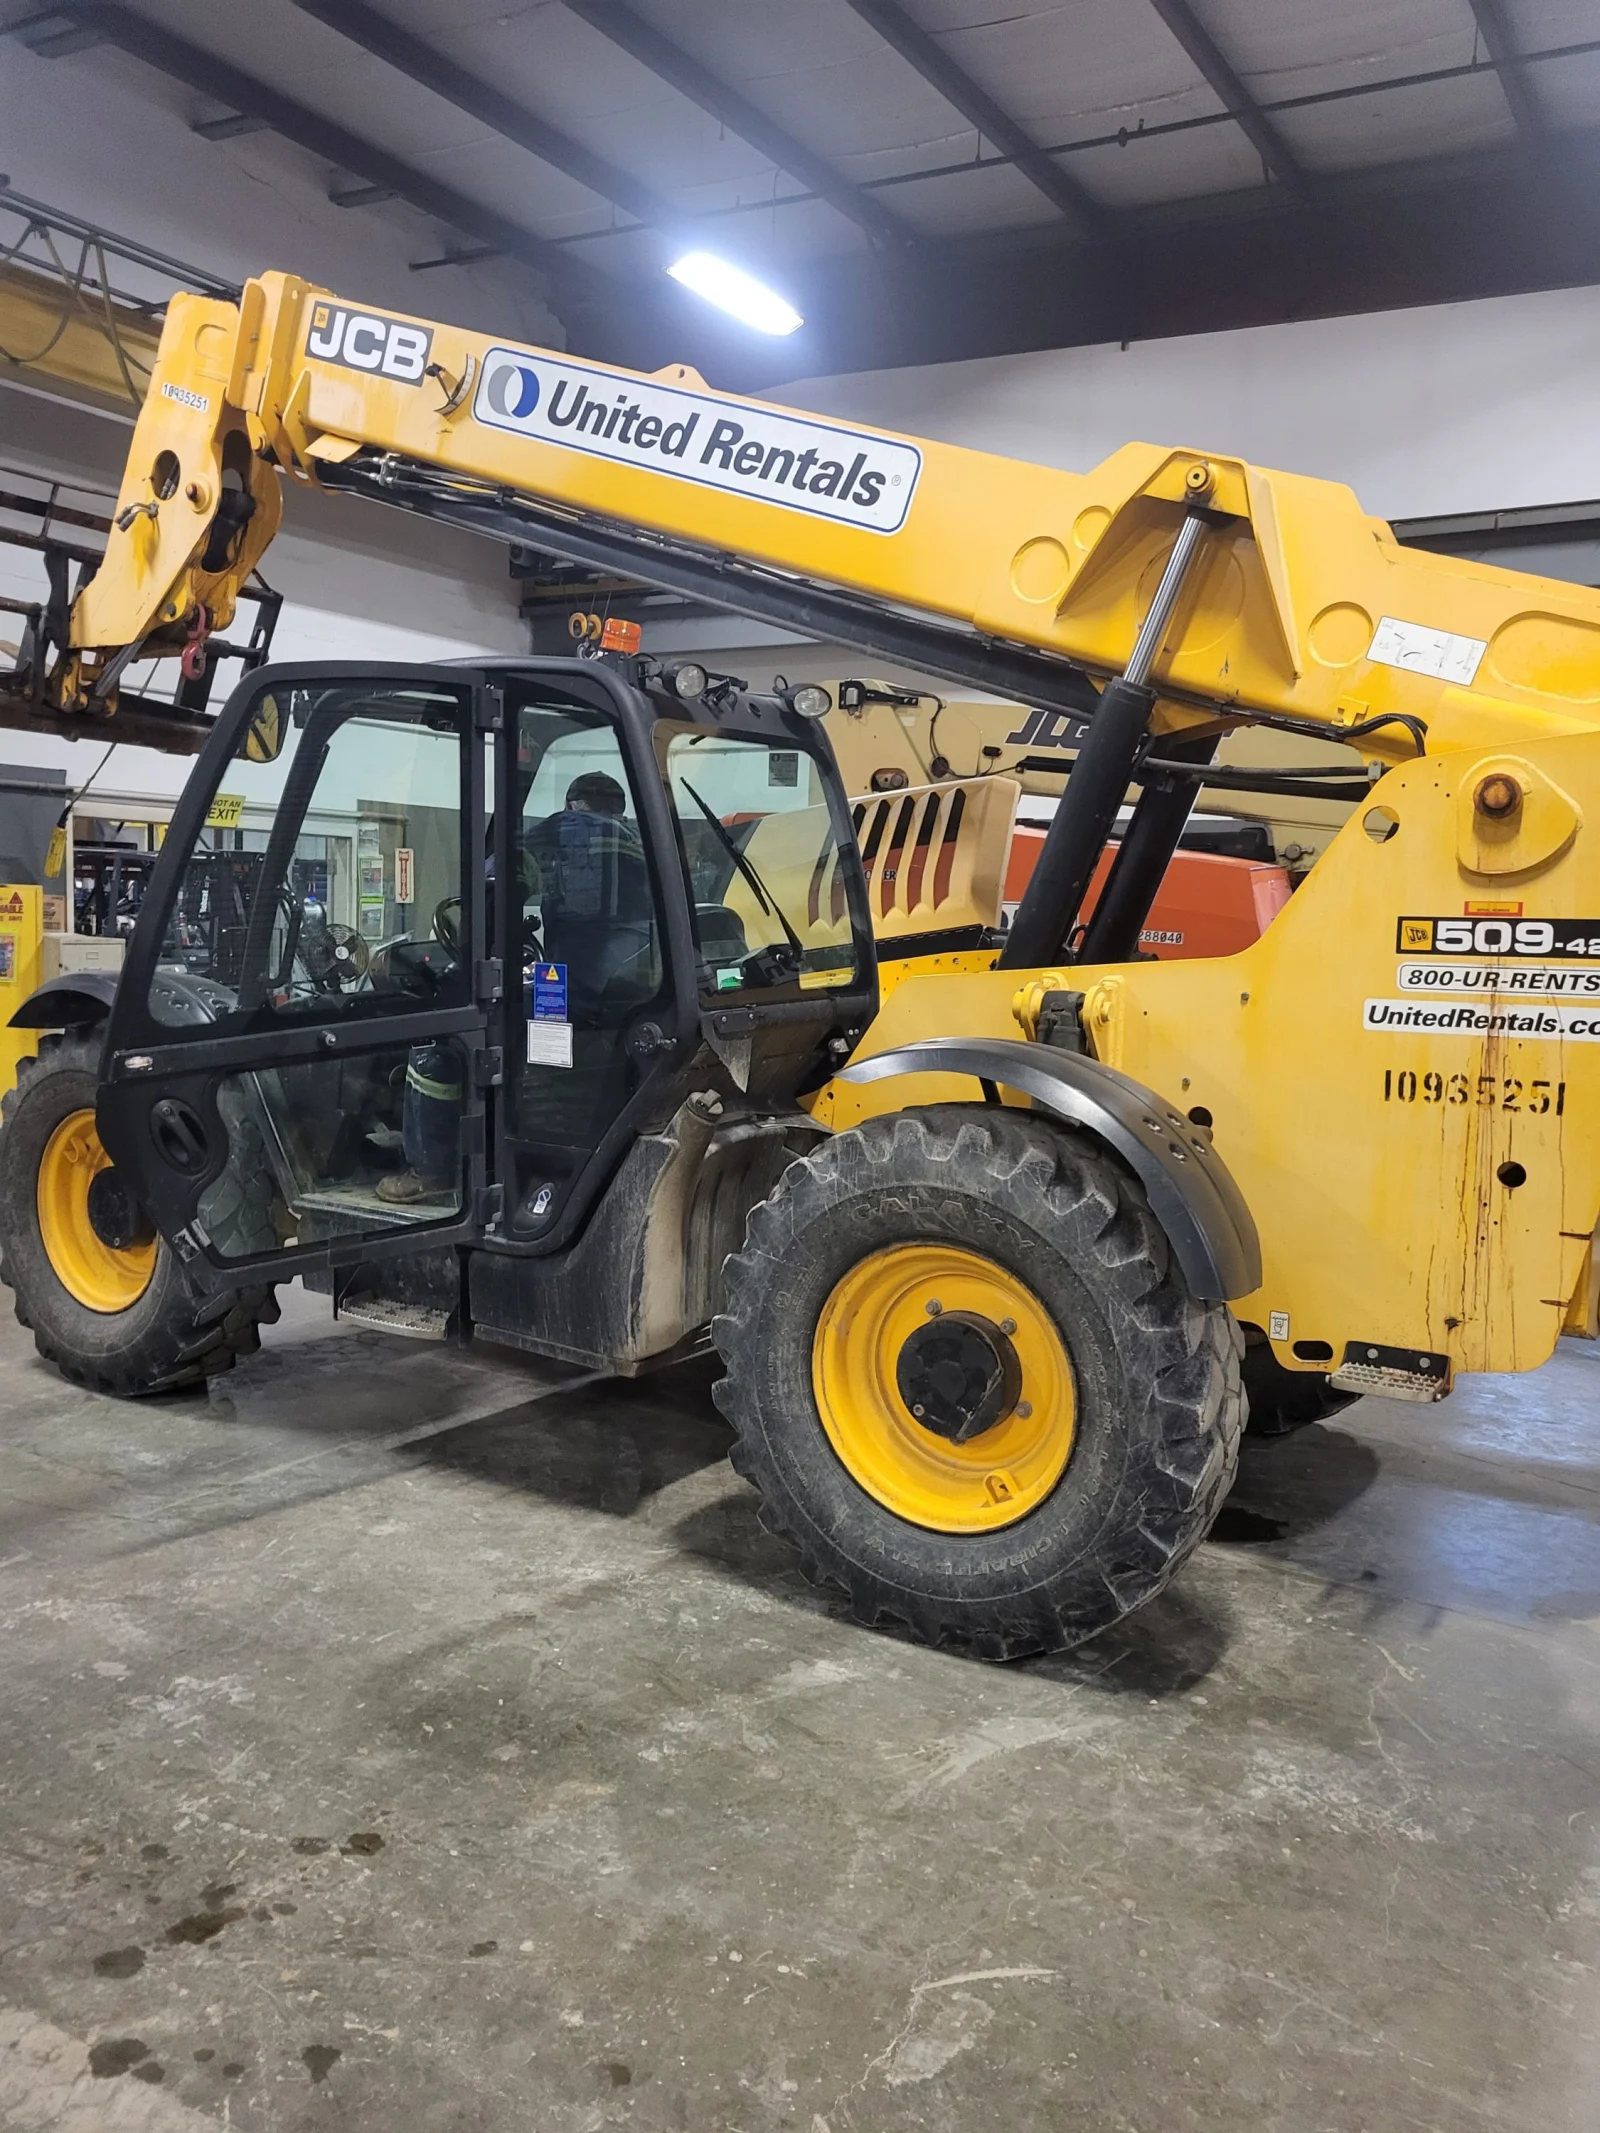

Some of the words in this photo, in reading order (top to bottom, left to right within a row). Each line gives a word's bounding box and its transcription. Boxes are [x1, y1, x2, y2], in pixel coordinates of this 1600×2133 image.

[310, 311, 428, 380] JCB
[163, 383, 208, 411] 10935251
[547, 380, 700, 457] United
[699, 419, 886, 506] Rentals
[207, 808, 238, 821] EXIT
[1408, 927, 1428, 943] JCB
[1408, 969, 1600, 992] 800-UR-RENTS
[1384, 1070, 1566, 1116] 10935251
